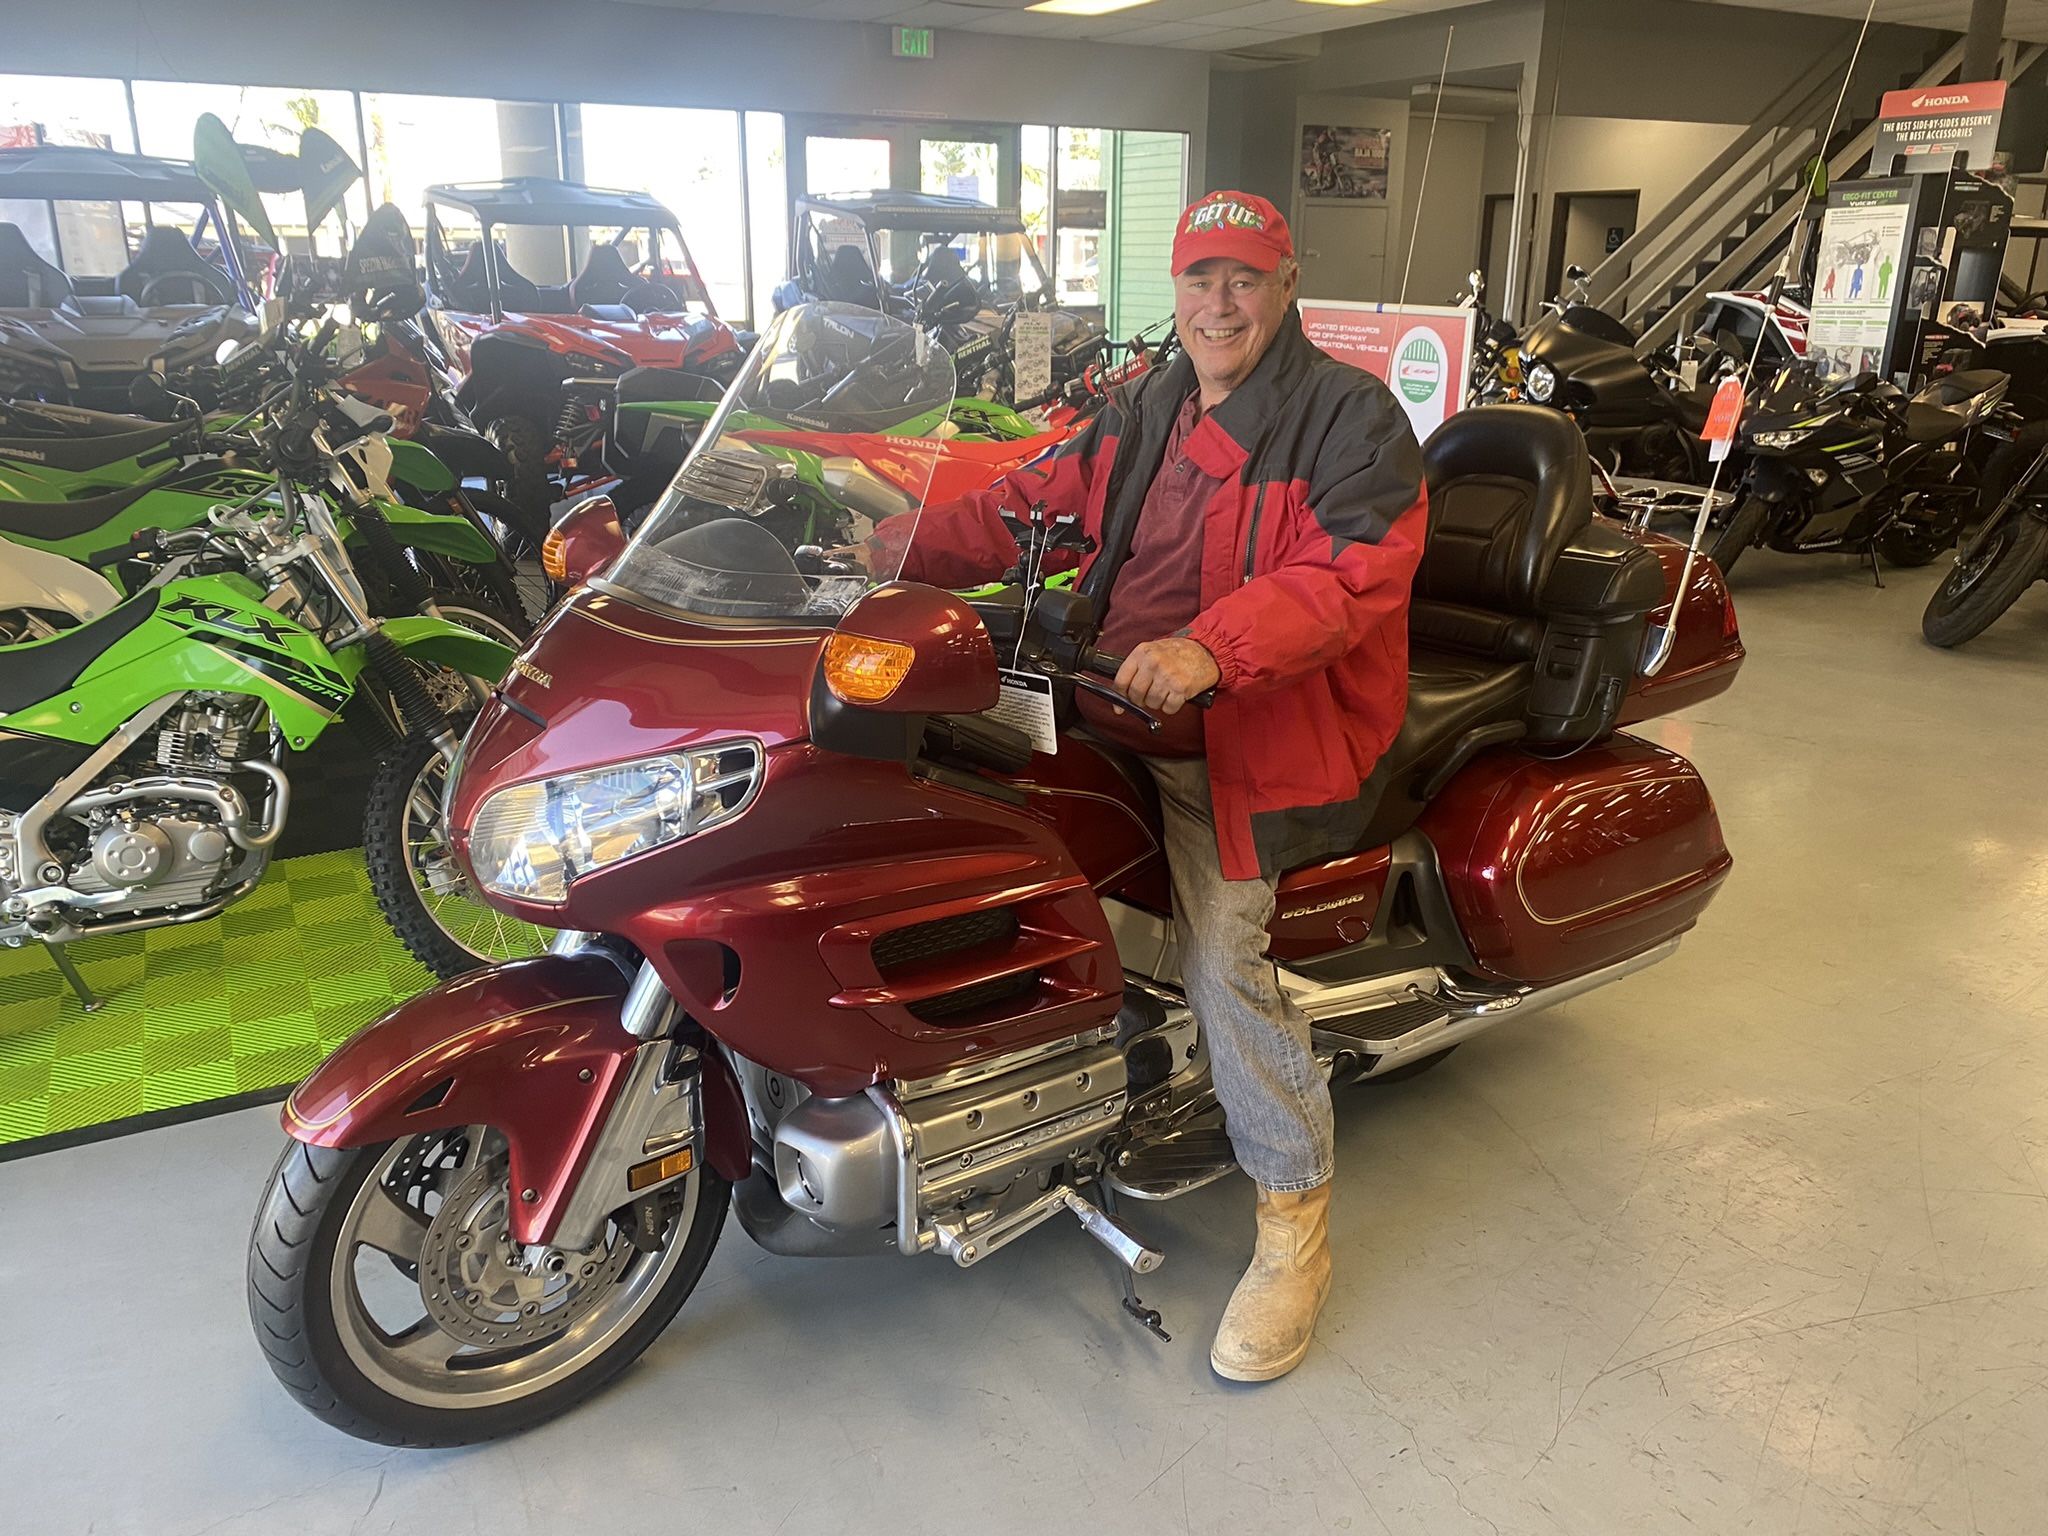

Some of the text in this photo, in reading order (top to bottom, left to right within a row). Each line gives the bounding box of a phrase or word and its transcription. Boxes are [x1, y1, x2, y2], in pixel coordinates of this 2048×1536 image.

[901, 28, 929, 56] EXIT
[1924, 95, 1970, 107] HONDA
[1883, 115, 1992, 132] THE BEST SIDE-BY-SIDES DESERVE
[1896, 128, 1973, 142] THE BEST ACCESSORIES
[1872, 190, 1899, 199] CENTER
[1195, 203, 1254, 226] GET LIT
[823, 316, 854, 338] TALON
[1308, 322, 1380, 334] UPDATED STANDARDS
[1322, 332, 1367, 342] OFF-HIGHWAY
[1356, 343, 1389, 353] VEHICLES
[786, 412, 830, 429] Kawasaki
[884, 435, 951, 452] HONDA
[158, 592, 308, 651] KLX
[1006, 678, 1028, 688] HONDA
